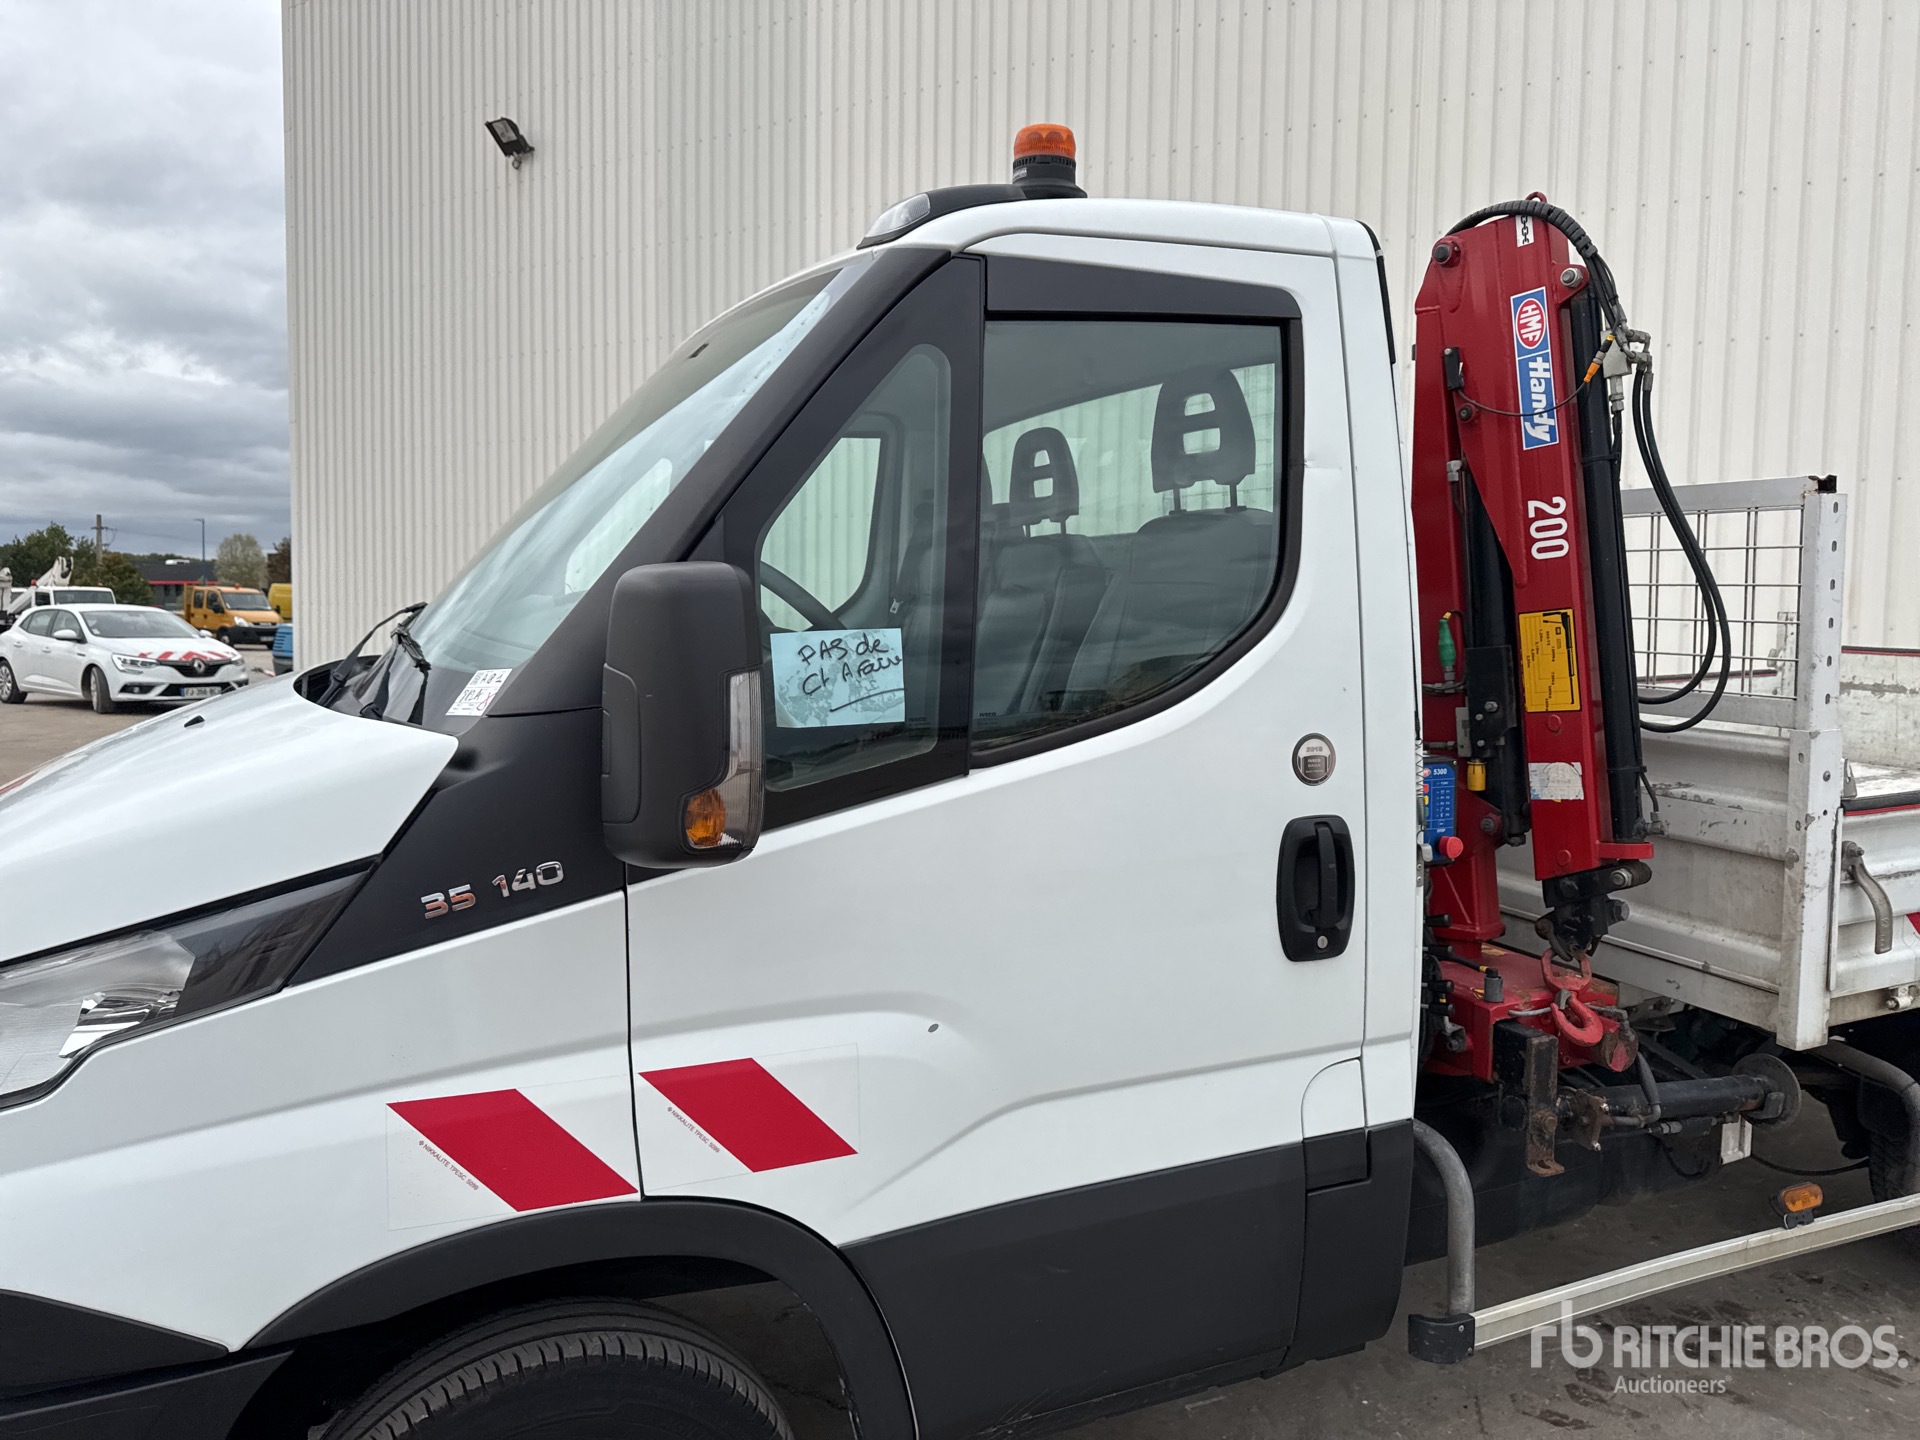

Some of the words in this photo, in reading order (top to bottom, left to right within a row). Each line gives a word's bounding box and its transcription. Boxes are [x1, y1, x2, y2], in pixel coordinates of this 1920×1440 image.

[1519, 303, 1543, 343] HMF
[1525, 356, 1555, 442] Handy
[1527, 495, 1570, 560] 200
[855, 632, 889, 656] de
[420, 883, 476, 920] 35
[491, 860, 564, 898] 140
[672, 1109, 696, 1132] NIKKALITE
[423, 1143, 451, 1168] NIKKALITE
